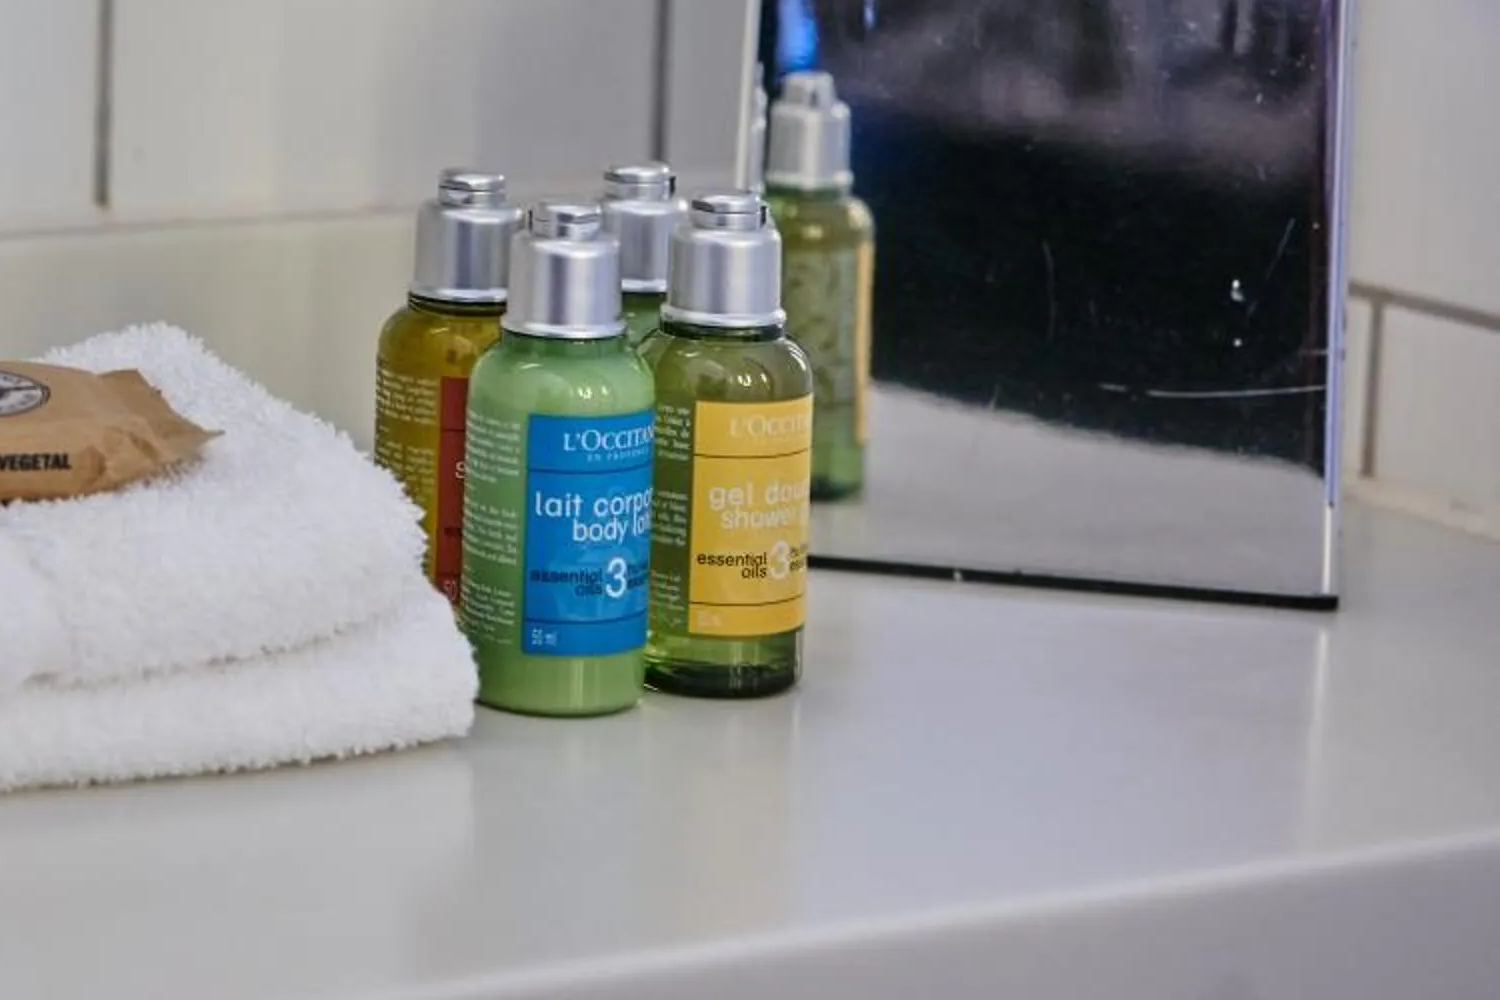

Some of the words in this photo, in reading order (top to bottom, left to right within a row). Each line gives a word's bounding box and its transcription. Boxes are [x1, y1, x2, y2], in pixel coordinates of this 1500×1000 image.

[535, 490, 584, 518] lait
[708, 476, 754, 512] gel
[573, 517, 629, 545] body
[696, 551, 768, 567] essential
[768, 540, 790, 580] 3
[741, 566, 768, 579] oils
[605, 556, 629, 599] 3
